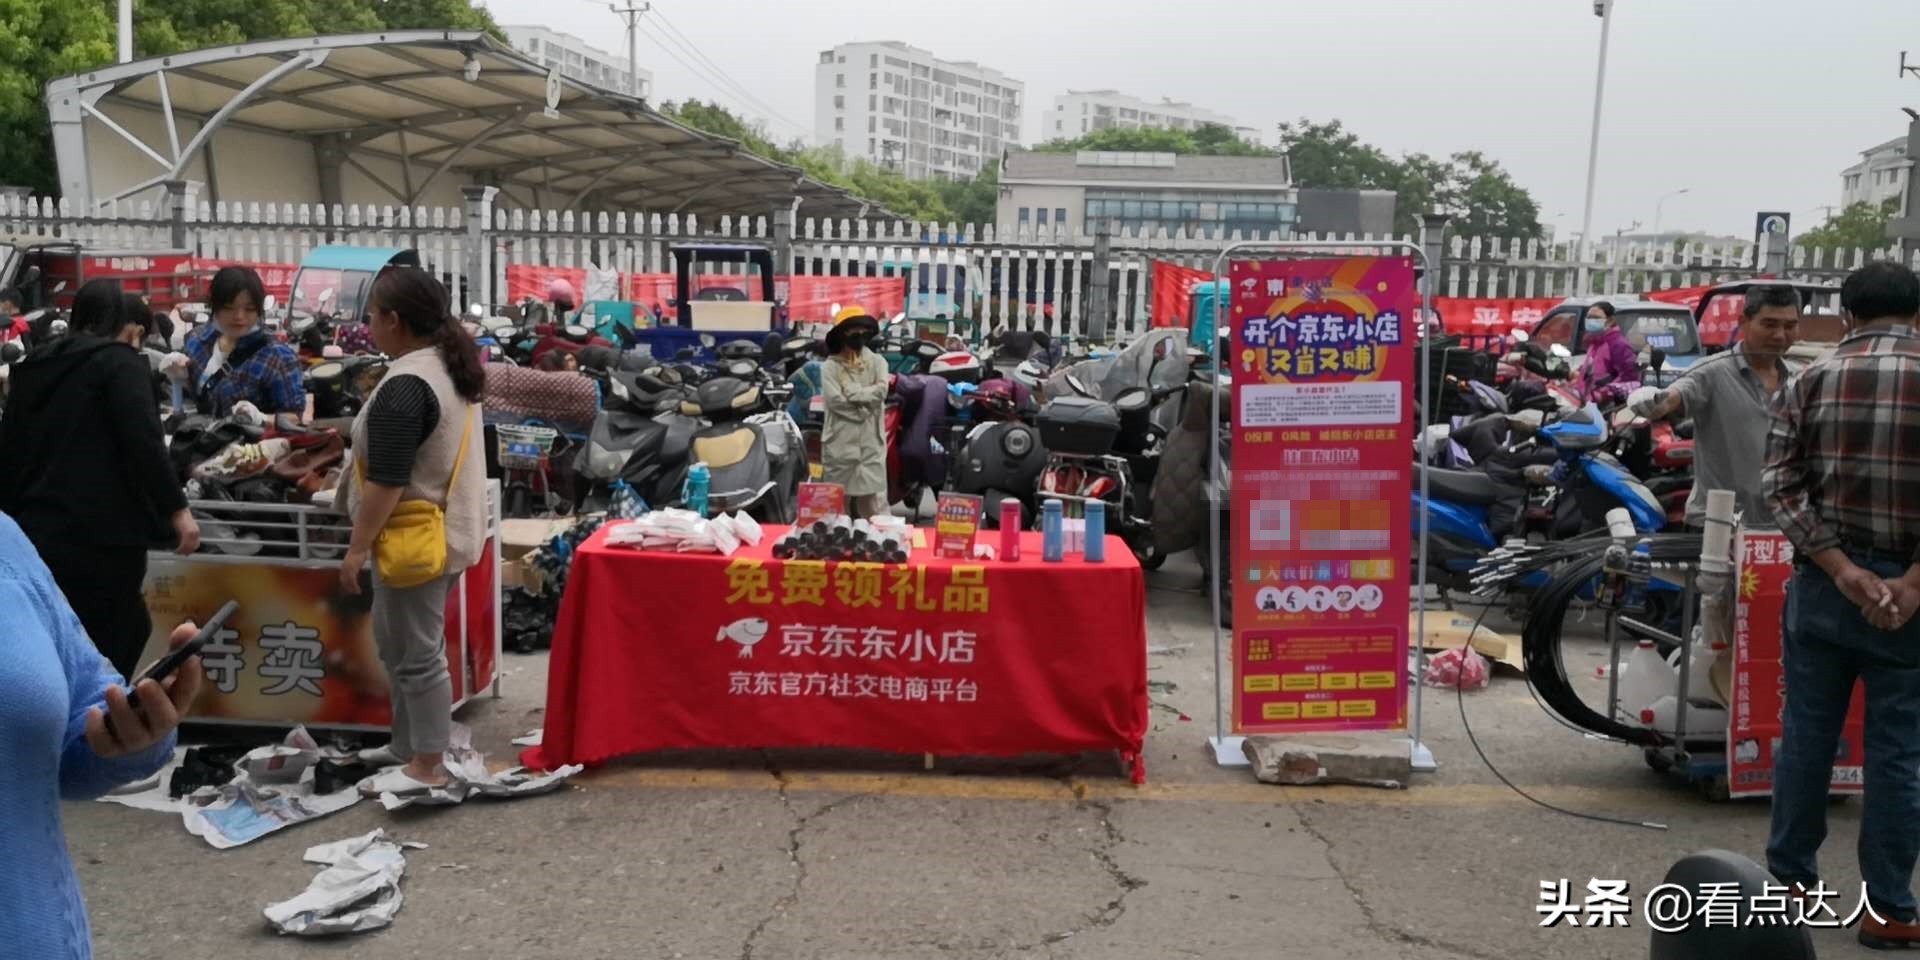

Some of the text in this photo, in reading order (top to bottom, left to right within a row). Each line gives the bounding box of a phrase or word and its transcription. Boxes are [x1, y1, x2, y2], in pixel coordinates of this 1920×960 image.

[1244, 312, 1399, 344] 开个京东小店
[1270, 345, 1372, 375] 又省又赚
[724, 557, 990, 613] 免费领礼品
[779, 622, 978, 664] 京东东小店
[728, 671, 979, 703] 京东官方社交电商平台
